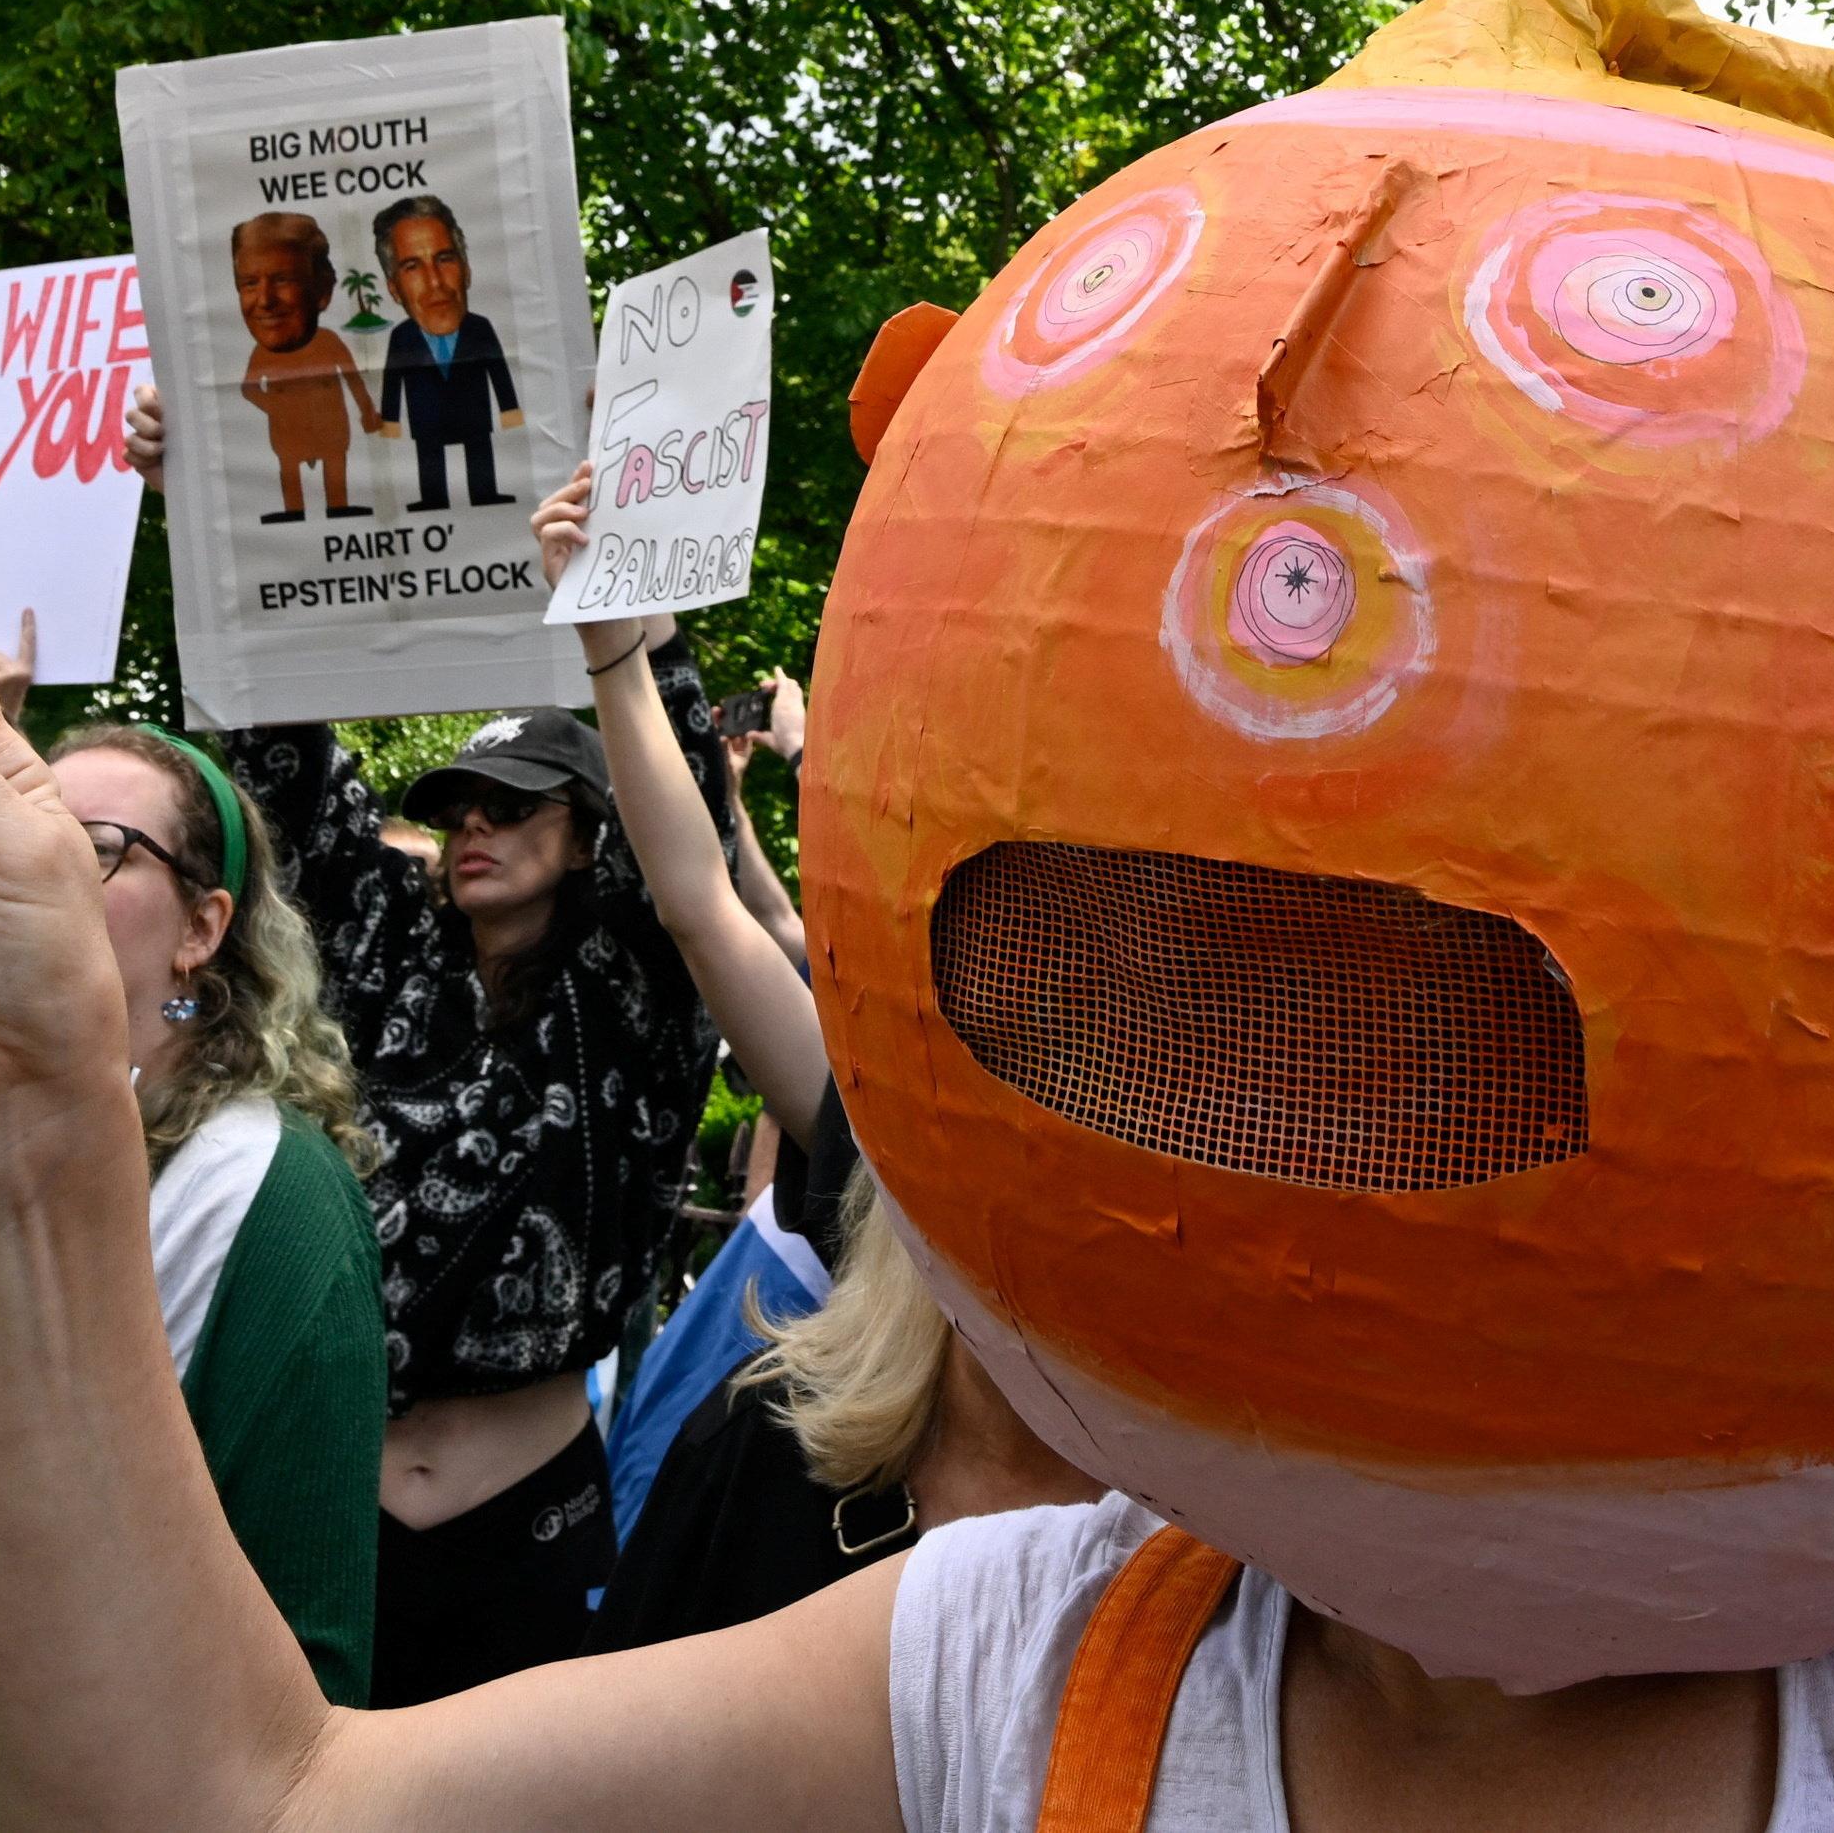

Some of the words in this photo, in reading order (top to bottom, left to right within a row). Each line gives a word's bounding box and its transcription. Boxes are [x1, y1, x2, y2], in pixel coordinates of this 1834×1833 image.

[250, 131, 302, 164] BIG
[309, 116, 429, 157] MOUTH
[259, 170, 329, 204] WEE
[335, 159, 429, 196] COCK
[0, 266, 152, 378] WIFE
[619, 275, 701, 366] NO
[587, 378, 769, 514] FASCIST
[323, 527, 414, 563] PAIRT
[423, 524, 455, 553] O'
[577, 527, 755, 610] BAWBAGS
[259, 570, 419, 610] EPSTEIN'S
[425, 560, 534, 597] FLOCK
